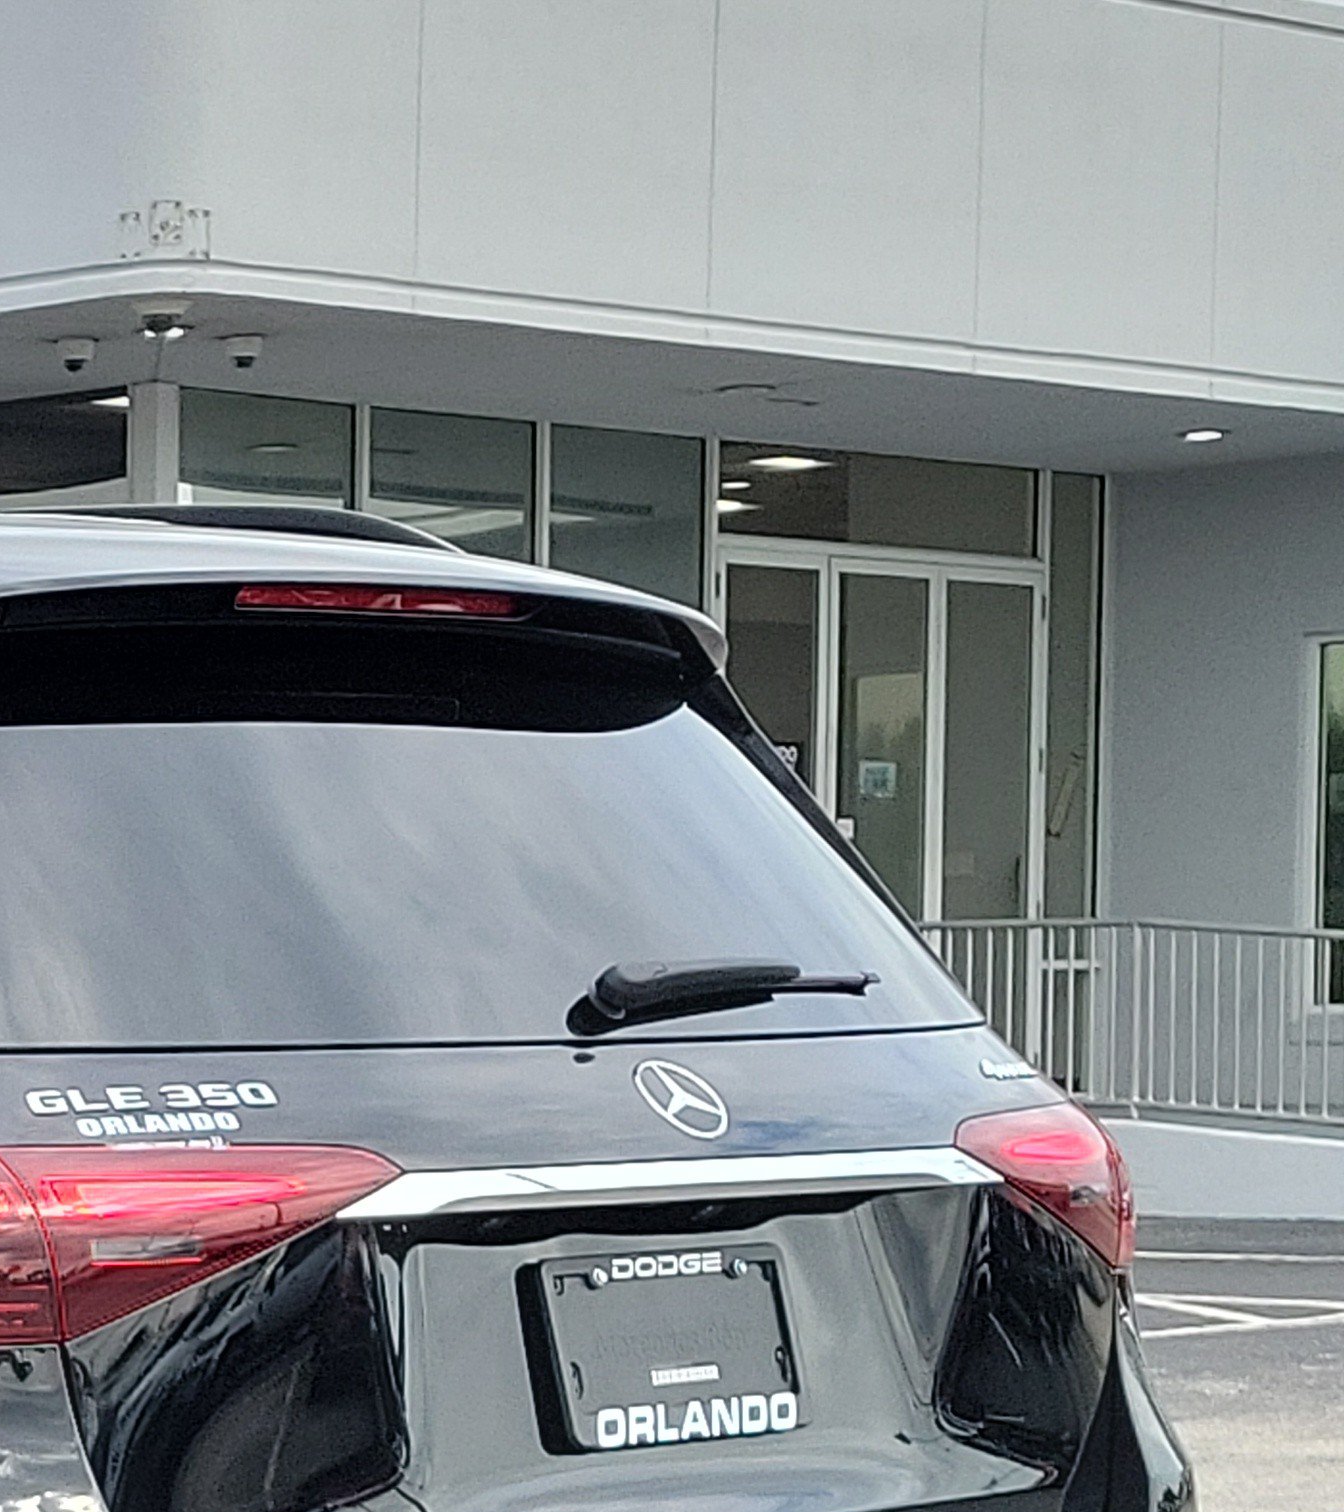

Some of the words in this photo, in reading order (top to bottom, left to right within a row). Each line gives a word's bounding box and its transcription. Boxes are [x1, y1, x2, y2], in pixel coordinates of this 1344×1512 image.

[25, 1084, 151, 1116] GLE
[159, 1080, 279, 1110] 350
[76, 1111, 241, 1138] ORLANDO
[611, 1251, 723, 1280] DODGE
[596, 1391, 798, 1448] ORLANDO
